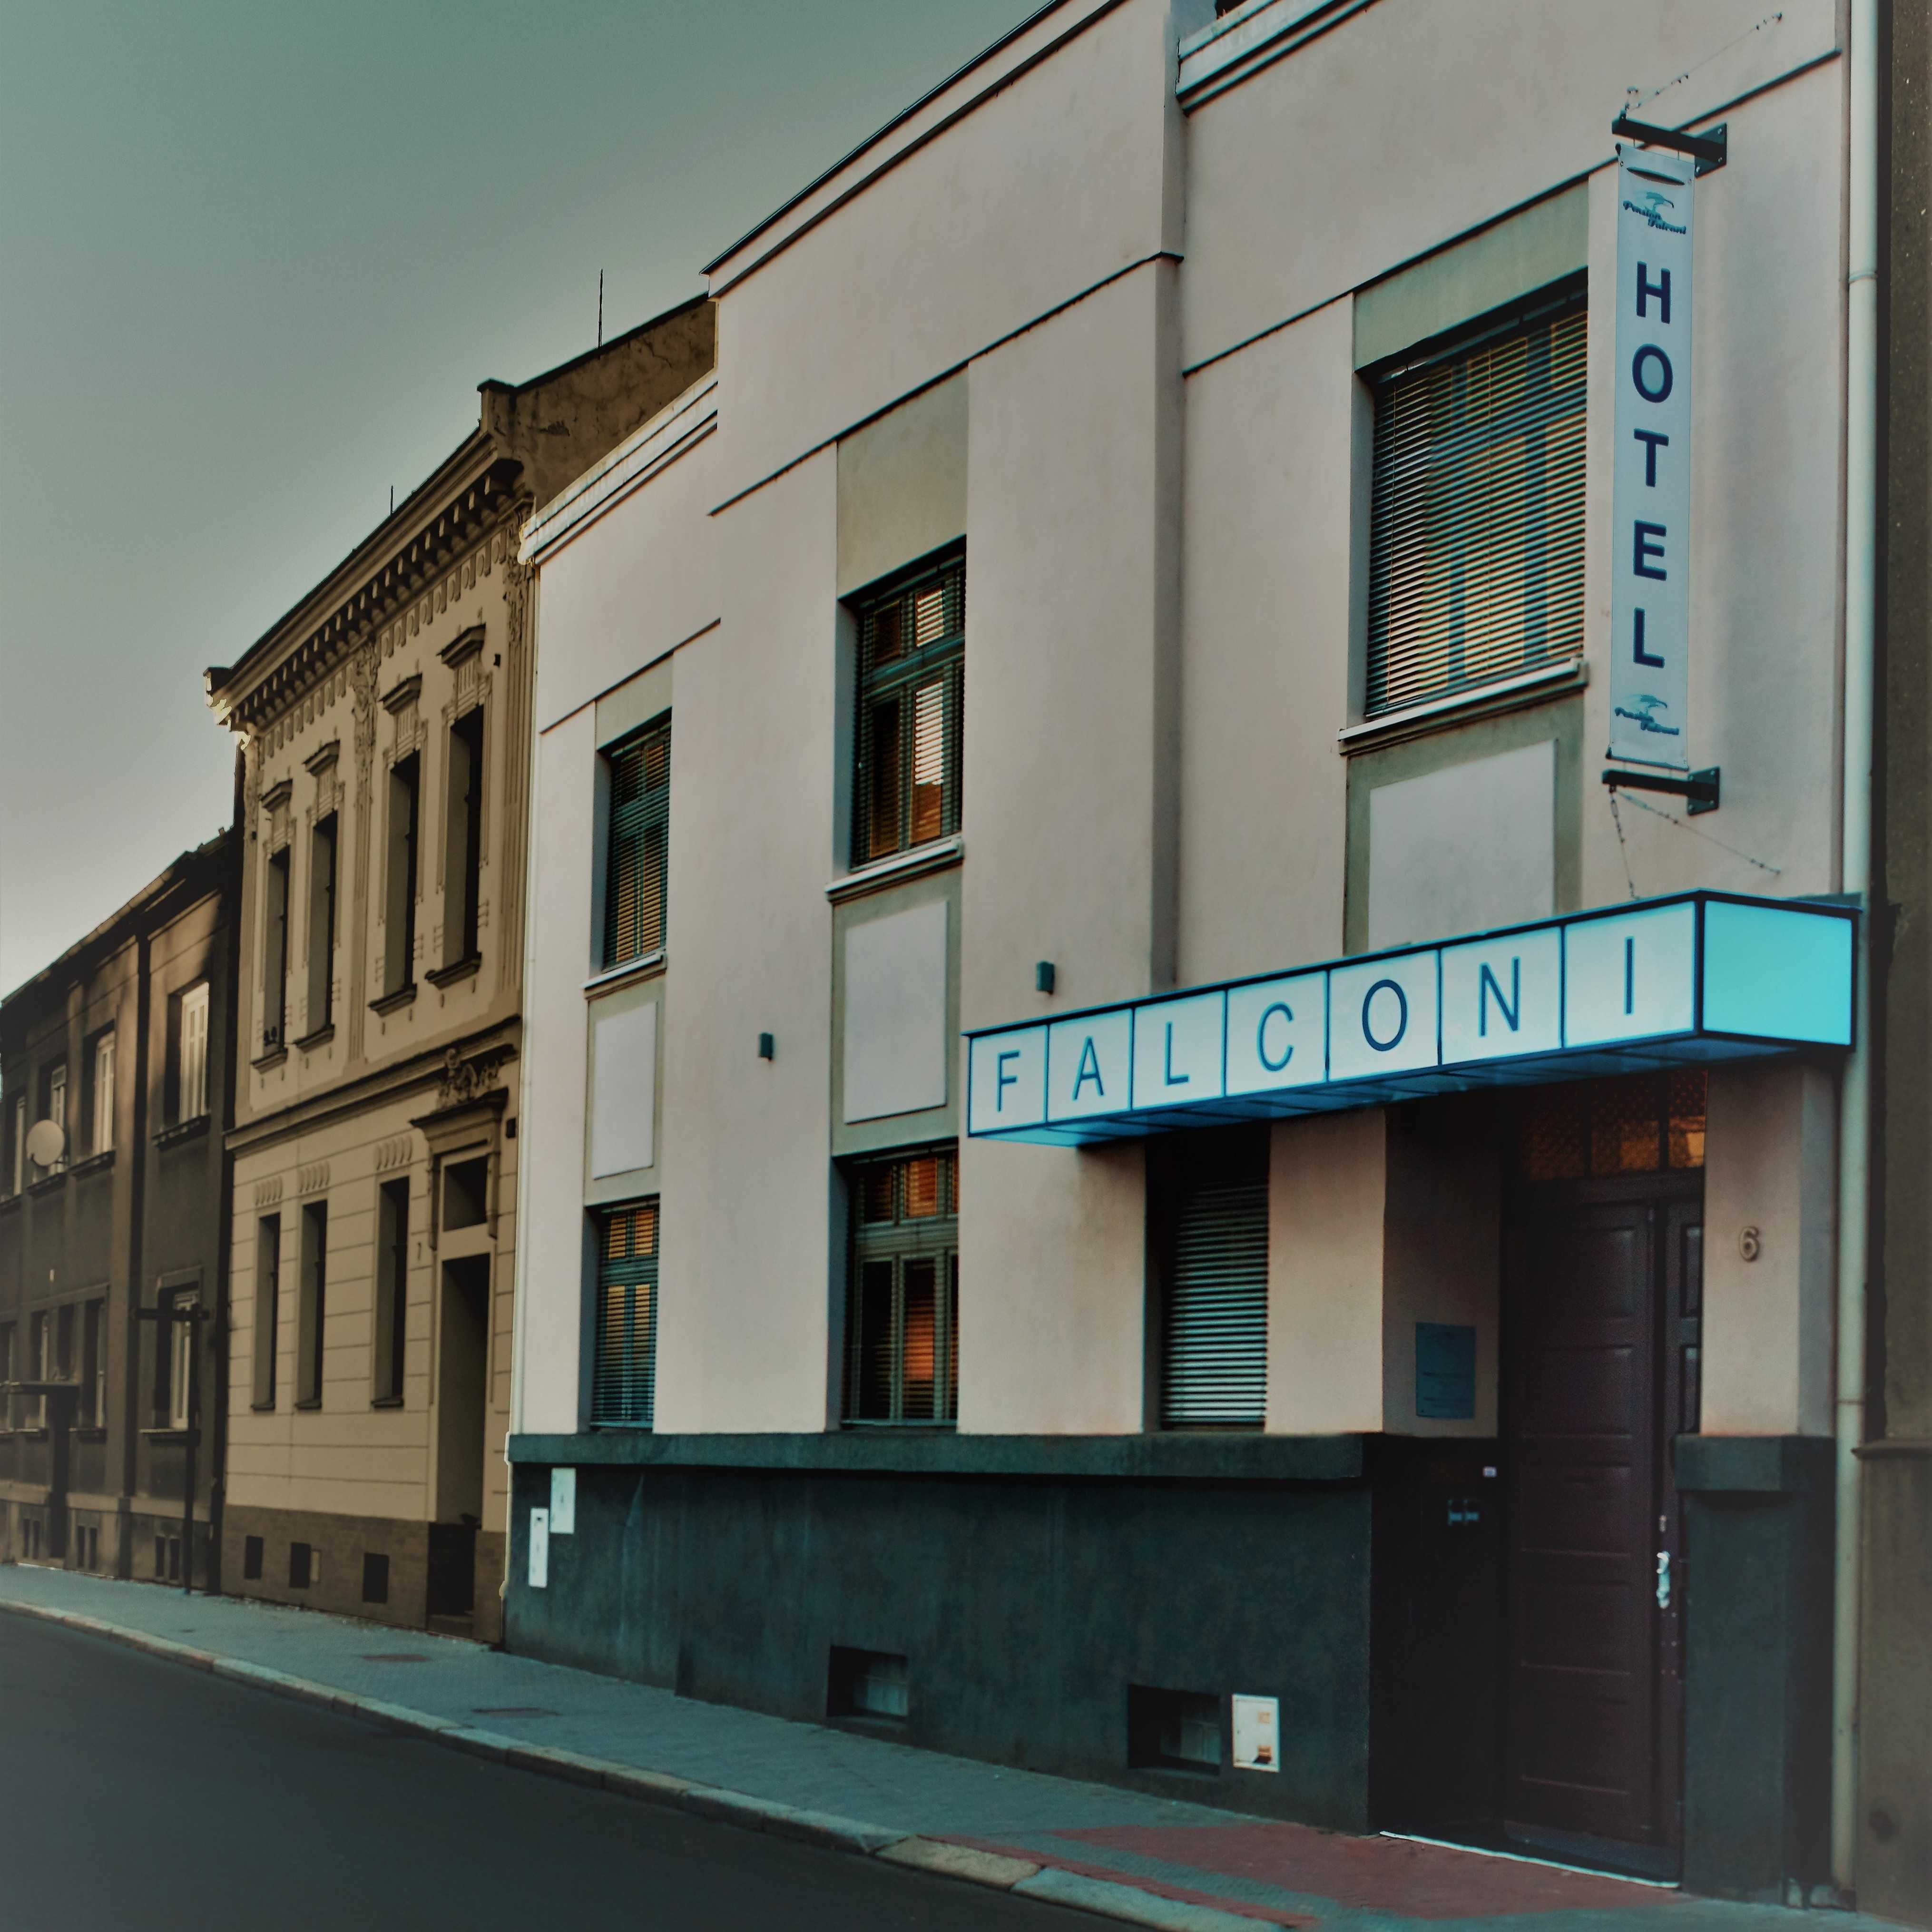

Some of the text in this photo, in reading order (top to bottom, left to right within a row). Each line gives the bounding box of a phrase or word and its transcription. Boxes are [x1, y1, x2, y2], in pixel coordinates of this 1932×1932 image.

[1632, 261, 1673, 668] HOTEL
[997, 936, 1634, 1112] FALCONI
[1740, 1226, 1760, 1263] 6
